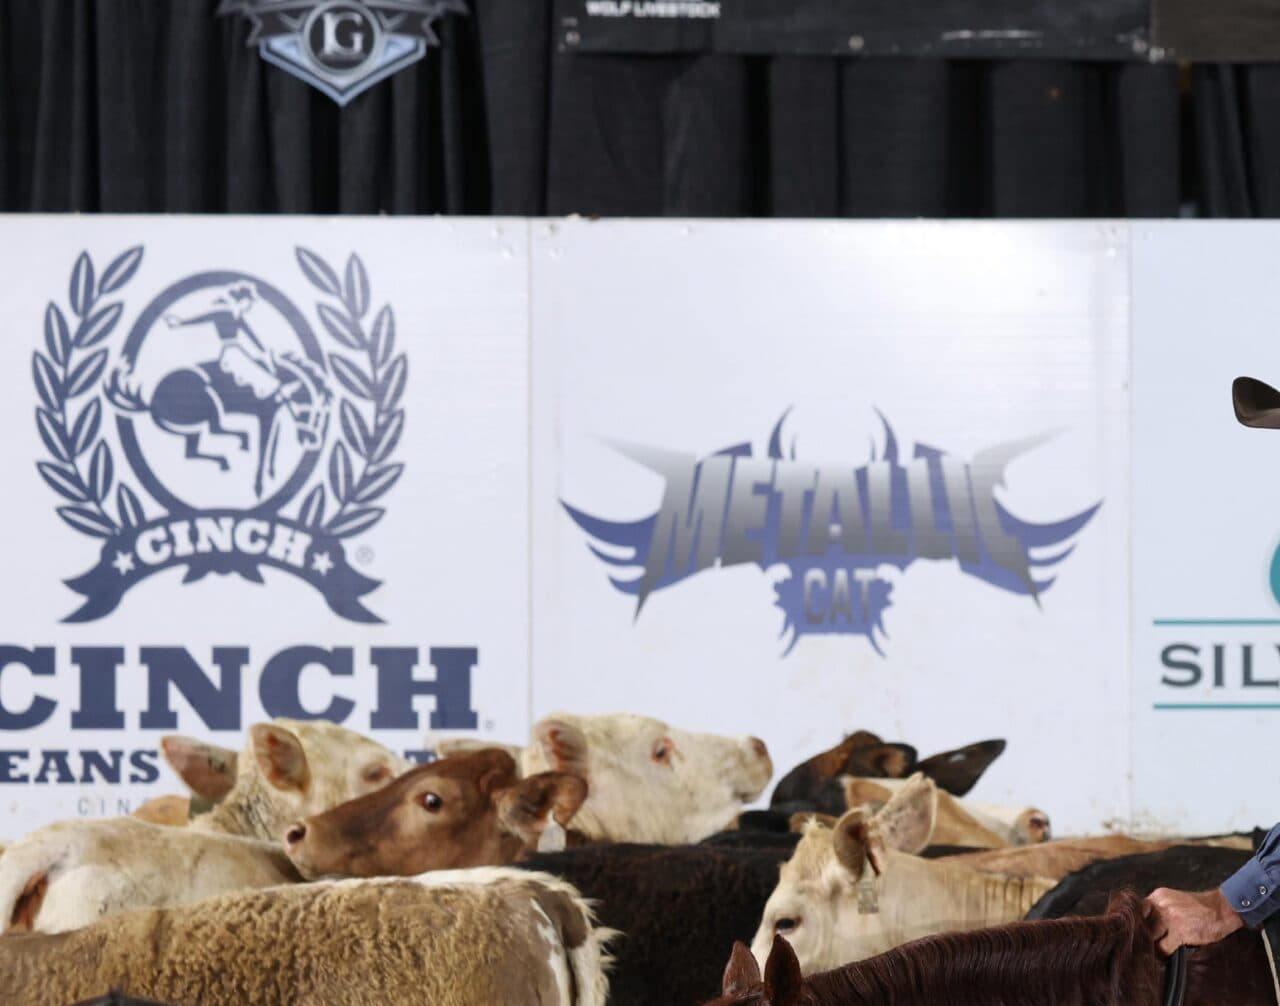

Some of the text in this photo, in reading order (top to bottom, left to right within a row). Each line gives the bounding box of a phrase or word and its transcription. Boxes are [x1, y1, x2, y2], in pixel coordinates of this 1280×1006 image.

[135, 516, 313, 568] CINCH
[600, 430, 1065, 615] METALLIC
[803, 568, 875, 625] CAT
[0, 644, 479, 730] CINCH
